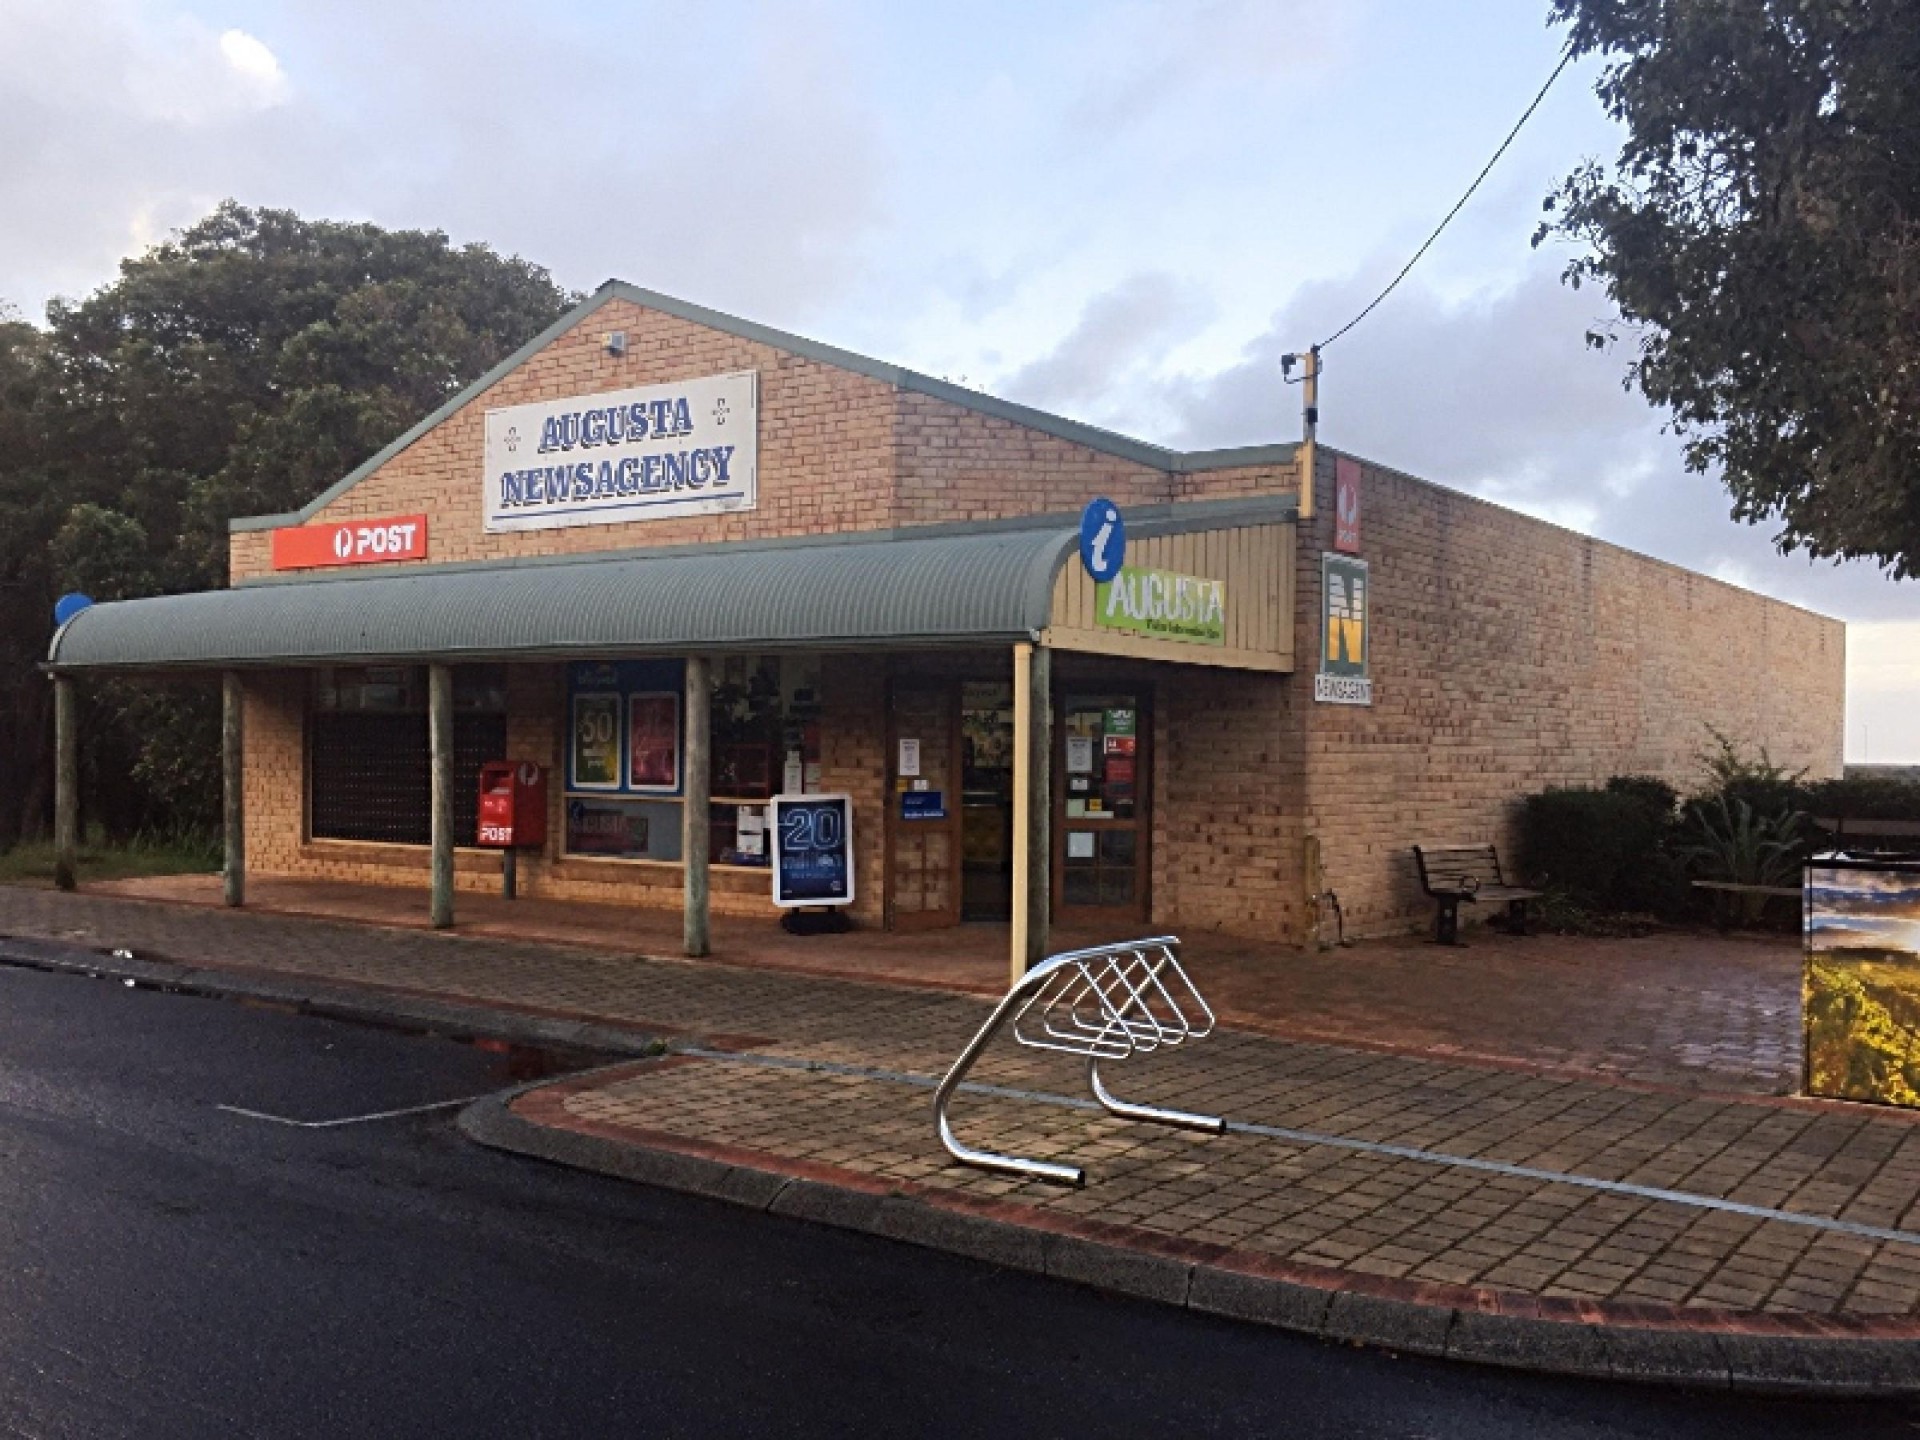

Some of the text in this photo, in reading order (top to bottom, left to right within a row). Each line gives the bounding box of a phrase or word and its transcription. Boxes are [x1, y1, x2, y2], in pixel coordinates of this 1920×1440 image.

[537, 397, 694, 454] AUGUSTA
[500, 446, 735, 507] NEWSAGENCY
[357, 523, 416, 556] POST
[1106, 571, 1225, 624] AUGUSTA
[1316, 678, 1371, 699] NEWSAGENT
[480, 827, 512, 841] POST
